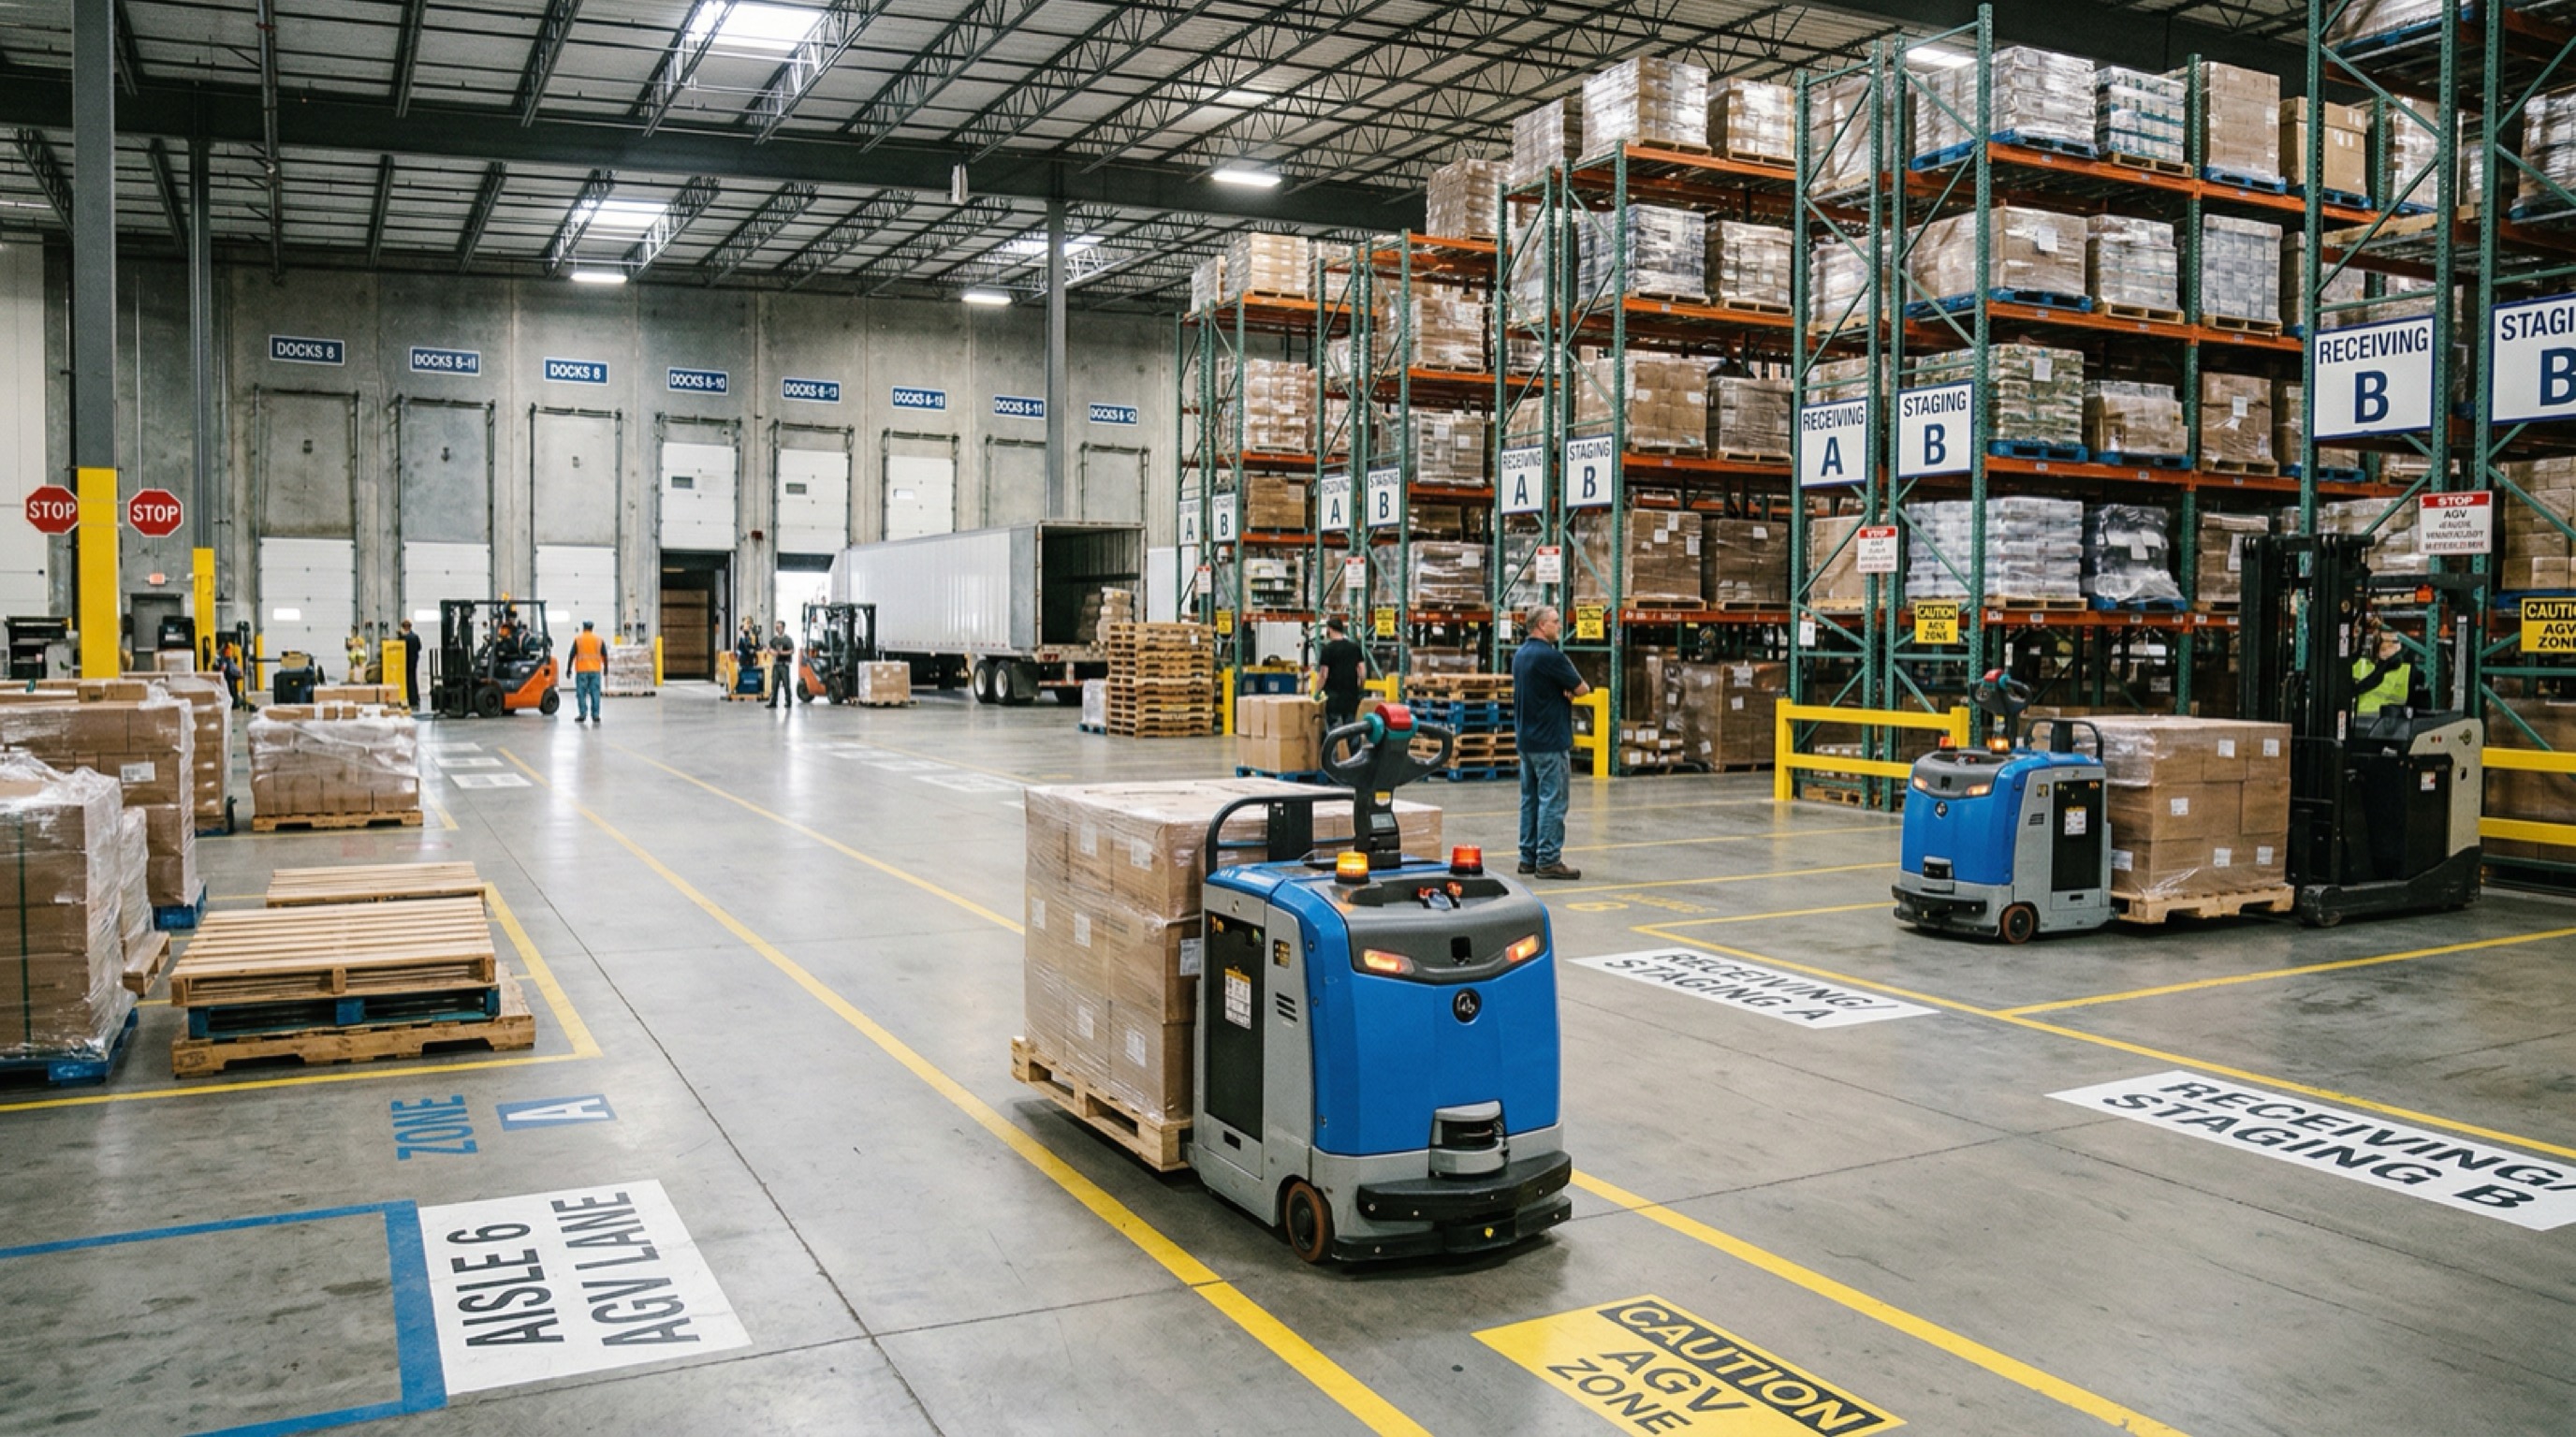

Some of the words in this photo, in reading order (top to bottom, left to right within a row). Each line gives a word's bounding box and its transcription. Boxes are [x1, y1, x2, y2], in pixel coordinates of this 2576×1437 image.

[2500, 306, 2576, 342] STAGI
[276, 342, 324, 359] DOCKS
[326, 346, 335, 359] 8
[2319, 326, 2429, 365] RECEIVING
[414, 353, 452, 368] DOCKS
[549, 363, 591, 379] DOCKS
[593, 366, 601, 380] 8
[670, 373, 705, 388] DOCKS
[2539, 346, 2576, 408] B
[1902, 388, 1967, 418] STAGING
[2354, 370, 2390, 424] B
[1802, 405, 1864, 432] RECEIVING
[1569, 440, 1611, 462] STAGING
[1820, 435, 1844, 477] A
[1924, 423, 1947, 466] B
[1514, 474, 1530, 506] A
[1580, 465, 1596, 499] B
[29, 500, 77, 521] STOP
[132, 504, 179, 522] STOP
[1328, 498, 1341, 524] A
[1378, 491, 1389, 520] B
[2437, 495, 2474, 506] STOP
[2444, 509, 2467, 519] AGV
[1185, 517, 1194, 541] A
[1219, 512, 1229, 536] B
[1918, 606, 1955, 620] CAUTION
[2525, 602, 2576, 619] CAUTI
[2542, 623, 2576, 635] AGV
[1603, 958, 1792, 1009] STAGING
[1785, 1004, 1836, 1021] A
[506, 1096, 610, 1122] A
[390, 1093, 478, 1161] ZONE
[2101, 1092, 2442, 1185] STAGING
[2452, 1184, 2536, 1209] B
[446, 1222, 532, 1245] 6
[550, 1191, 660, 1271] LANE
[451, 1248, 565, 1347] AISLE
[581, 1277, 701, 1347] AGV
[1599, 1349, 1751, 1413] AGV
[1618, 1304, 1868, 1431] CAUTION
[1545, 1357, 1692, 1435] ZONE
